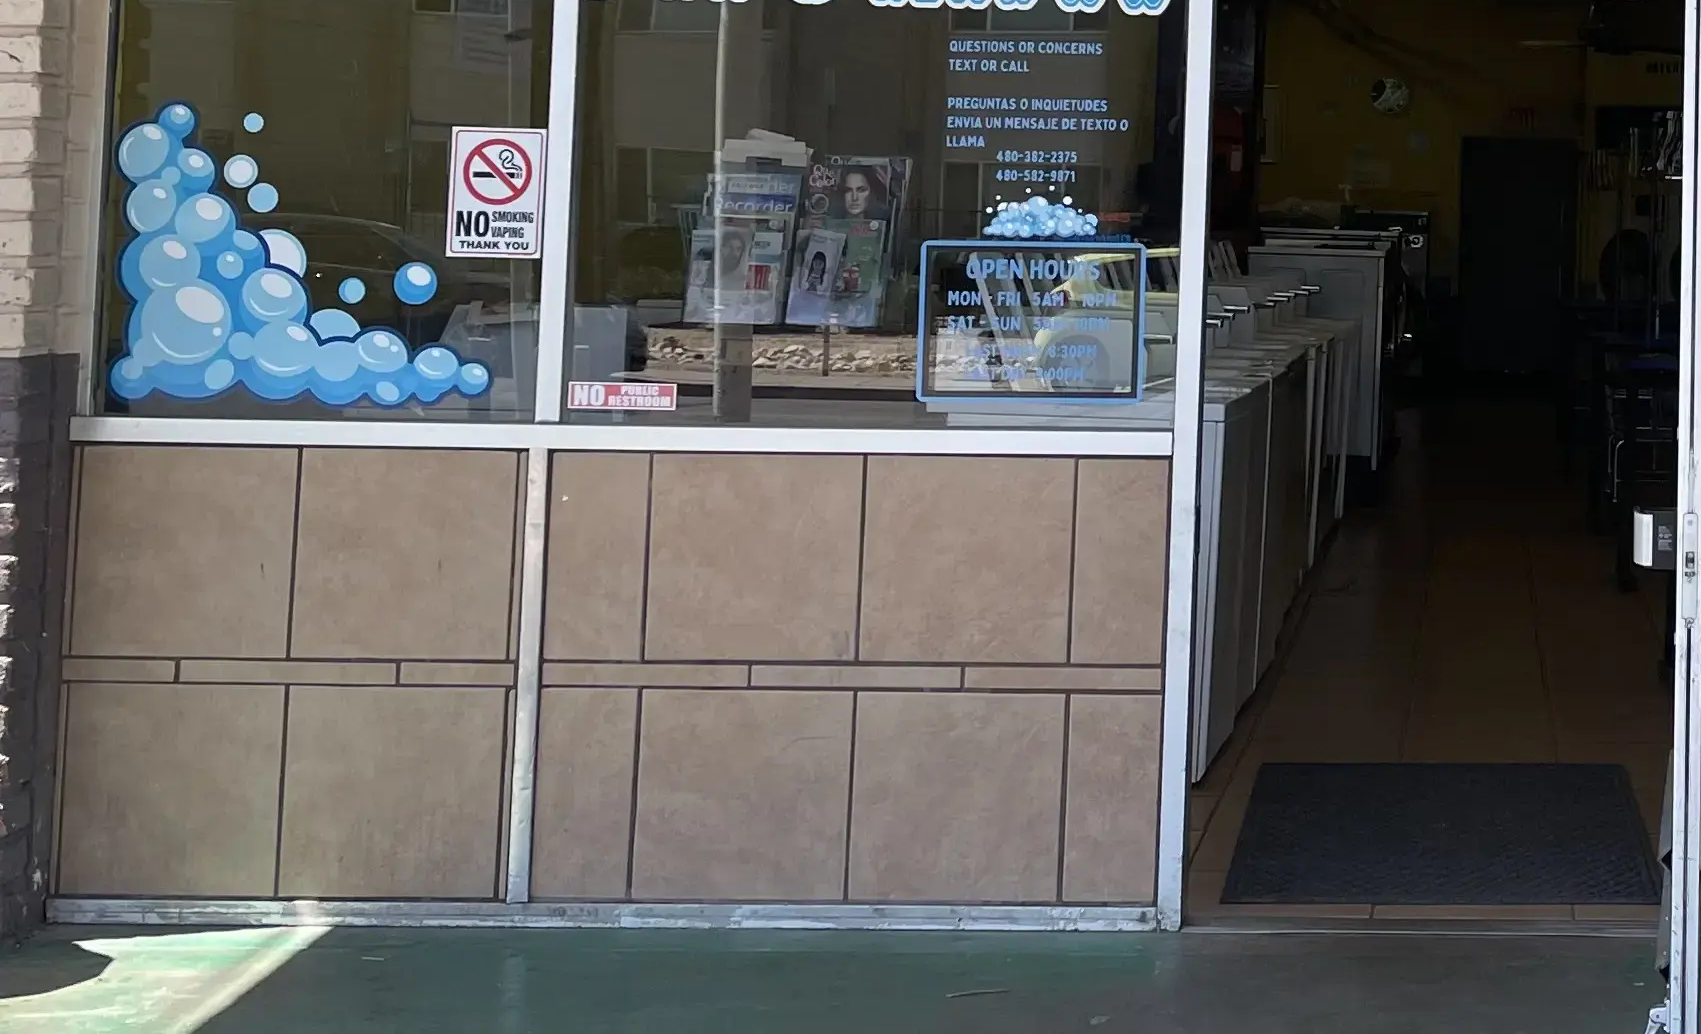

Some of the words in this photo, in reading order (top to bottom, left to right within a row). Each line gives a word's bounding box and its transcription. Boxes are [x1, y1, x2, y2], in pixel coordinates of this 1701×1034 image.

[949, 40, 1015, 53] QUESTIONS
[1018, 41, 1035, 54] OR
[1038, 42, 1103, 55] CONCERNS
[949, 59, 977, 71] TEXT
[980, 59, 997, 71] OR
[1000, 60, 1030, 72] CALL
[947, 97, 1017, 110] PREGUNTAS
[1019, 98, 1028, 110] O
[1031, 98, 1108, 112] INQUIETUDES
[947, 116, 982, 129] ENVIA
[985, 117, 1001, 129] UN
[1004, 117, 1059, 130] MENSAJE
[1061, 118, 1077, 130] DE
[1080, 118, 1117, 131] TEXTO
[1119, 119, 1129, 131] O
[945, 135, 986, 147] LLAMA
[996, 150, 1077, 163] 480-382-2375
[995, 169, 1076, 183] 480-582-9871
[455, 210, 490, 237] NO
[491, 211, 534, 223] SMOKING
[491, 227, 524, 238] VAPING
[459, 240, 500, 249] THANK
[504, 242, 529, 250] YOU
[965, 259, 1024, 280] OPEN
[1029, 259, 1101, 281] HOURS
[947, 290, 981, 306] MON
[997, 291, 1022, 306] FRI
[1032, 292, 1065, 307] 5AM
[947, 316, 976, 332] SAT
[993, 316, 1021, 331] SUN
[573, 385, 605, 406] NO
[621, 386, 659, 395] PUBLIC
[608, 395, 671, 407] RESTROOM
